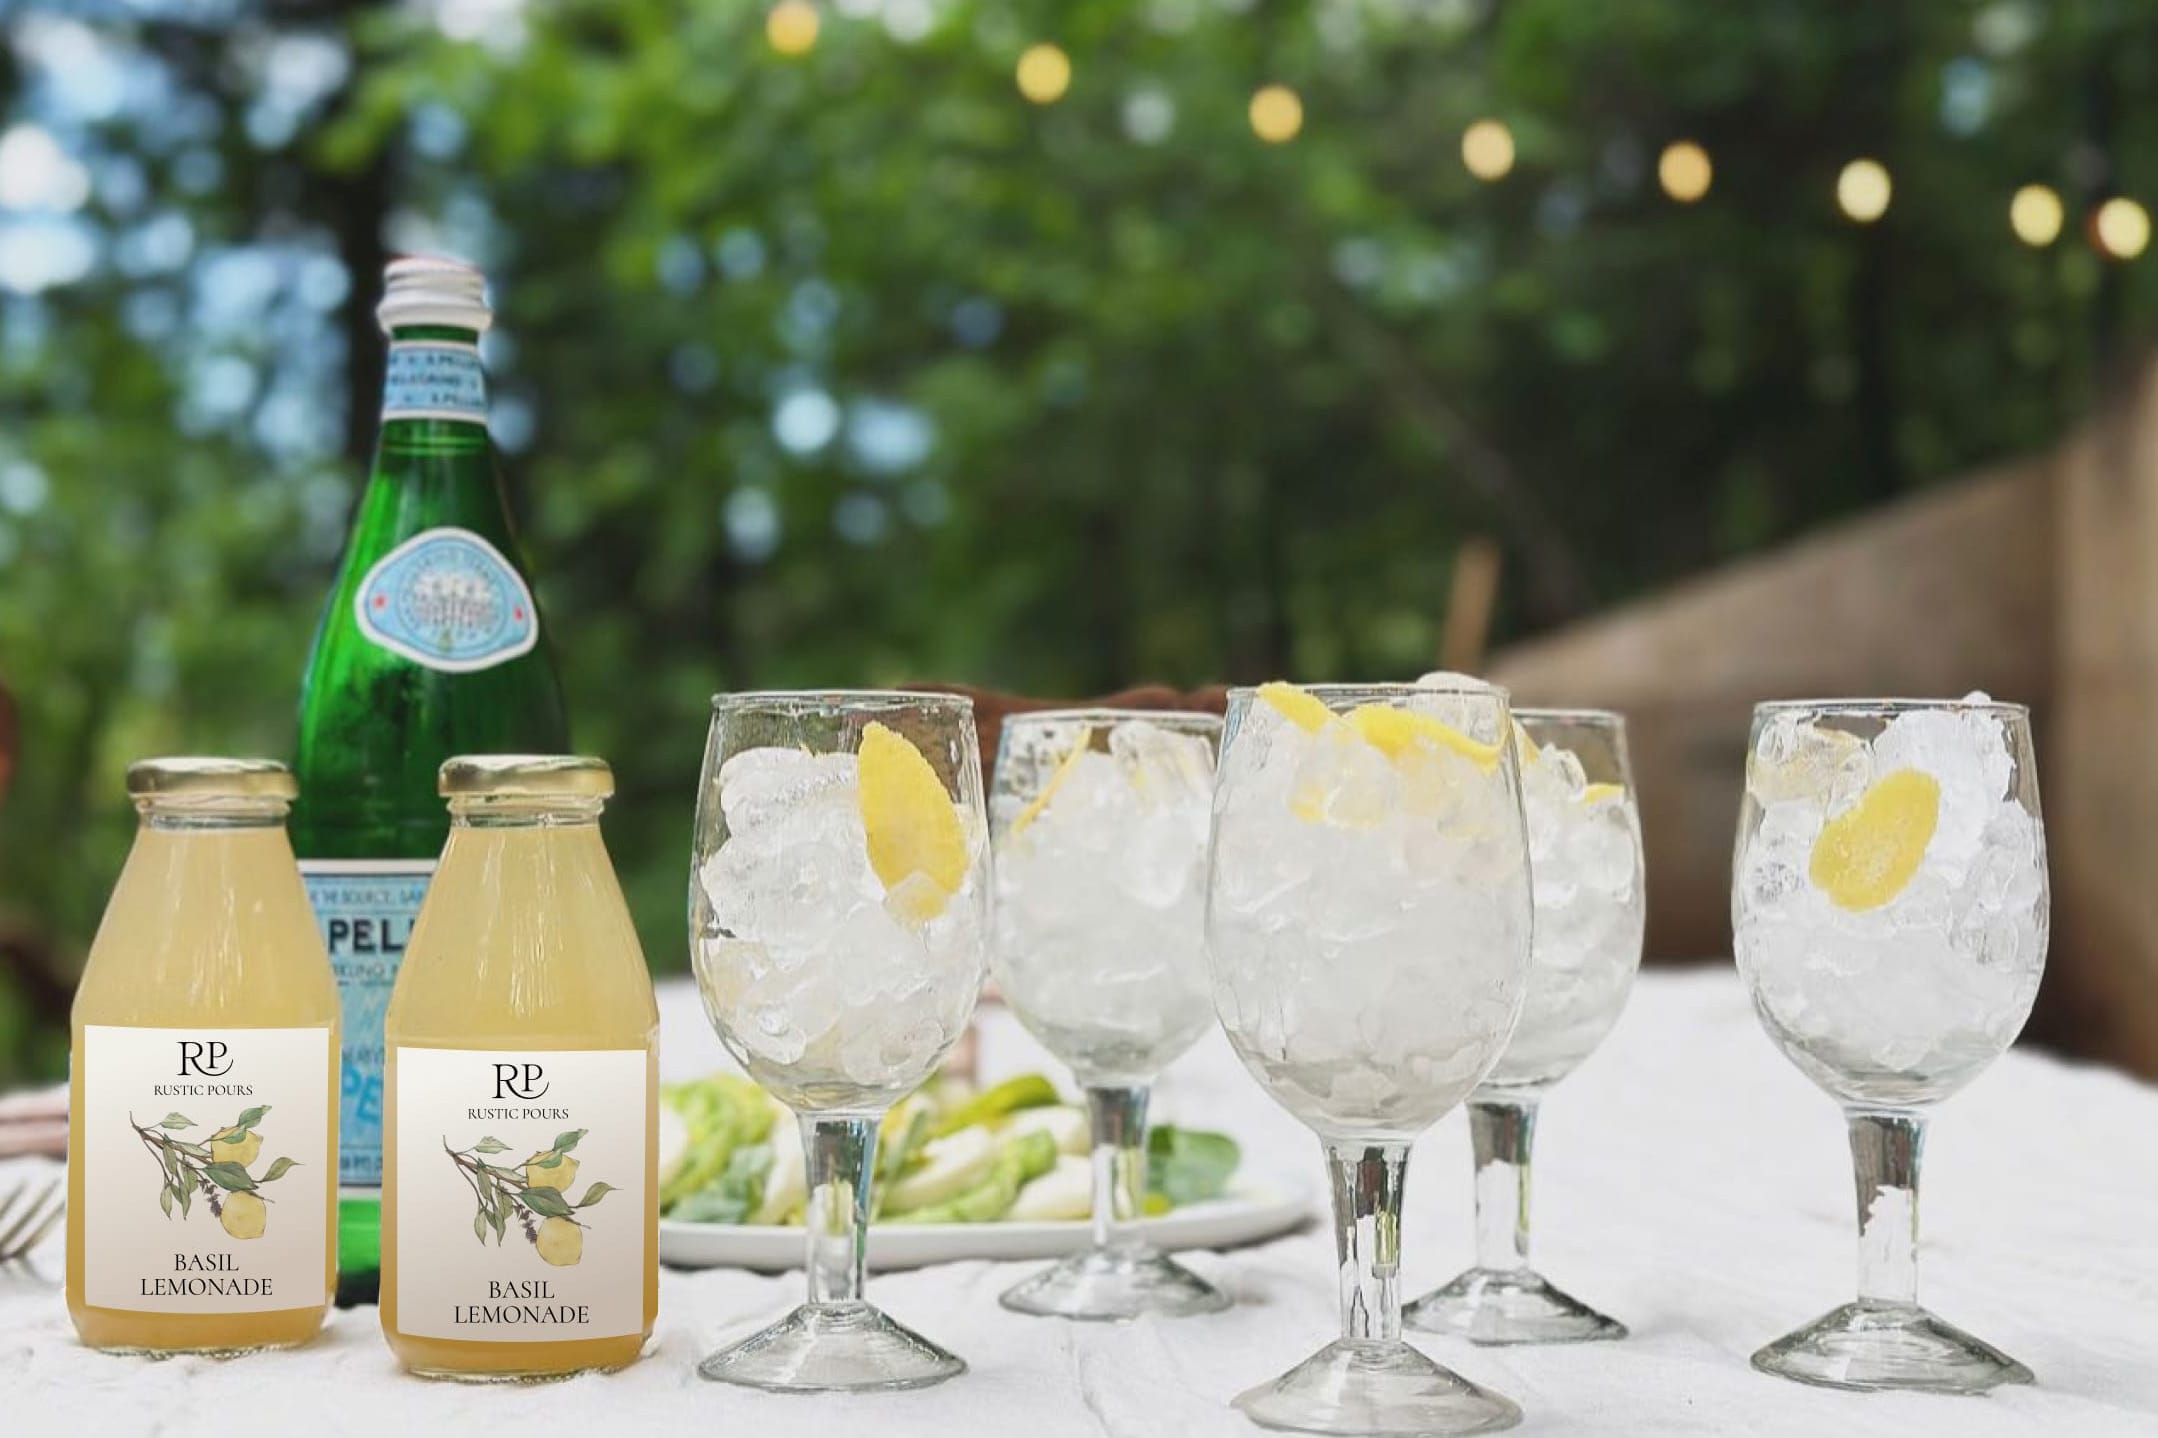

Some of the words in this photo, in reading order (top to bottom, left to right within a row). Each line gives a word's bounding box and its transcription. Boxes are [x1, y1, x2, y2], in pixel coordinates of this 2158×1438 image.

[328, 918, 415, 953] PEL
[176, 1041, 234, 1076] RP
[154, 1084, 204, 1096] RUSTIC
[207, 1084, 253, 1096] POURS
[491, 1063, 550, 1100] RP
[468, 1107, 519, 1120] RUSTIC
[523, 1107, 569, 1120] POURS
[174, 1253, 239, 1271] BASIL
[140, 1278, 273, 1296] LEMONADE
[488, 1280, 555, 1299] BASIL
[453, 1305, 590, 1324] LEMONADE
